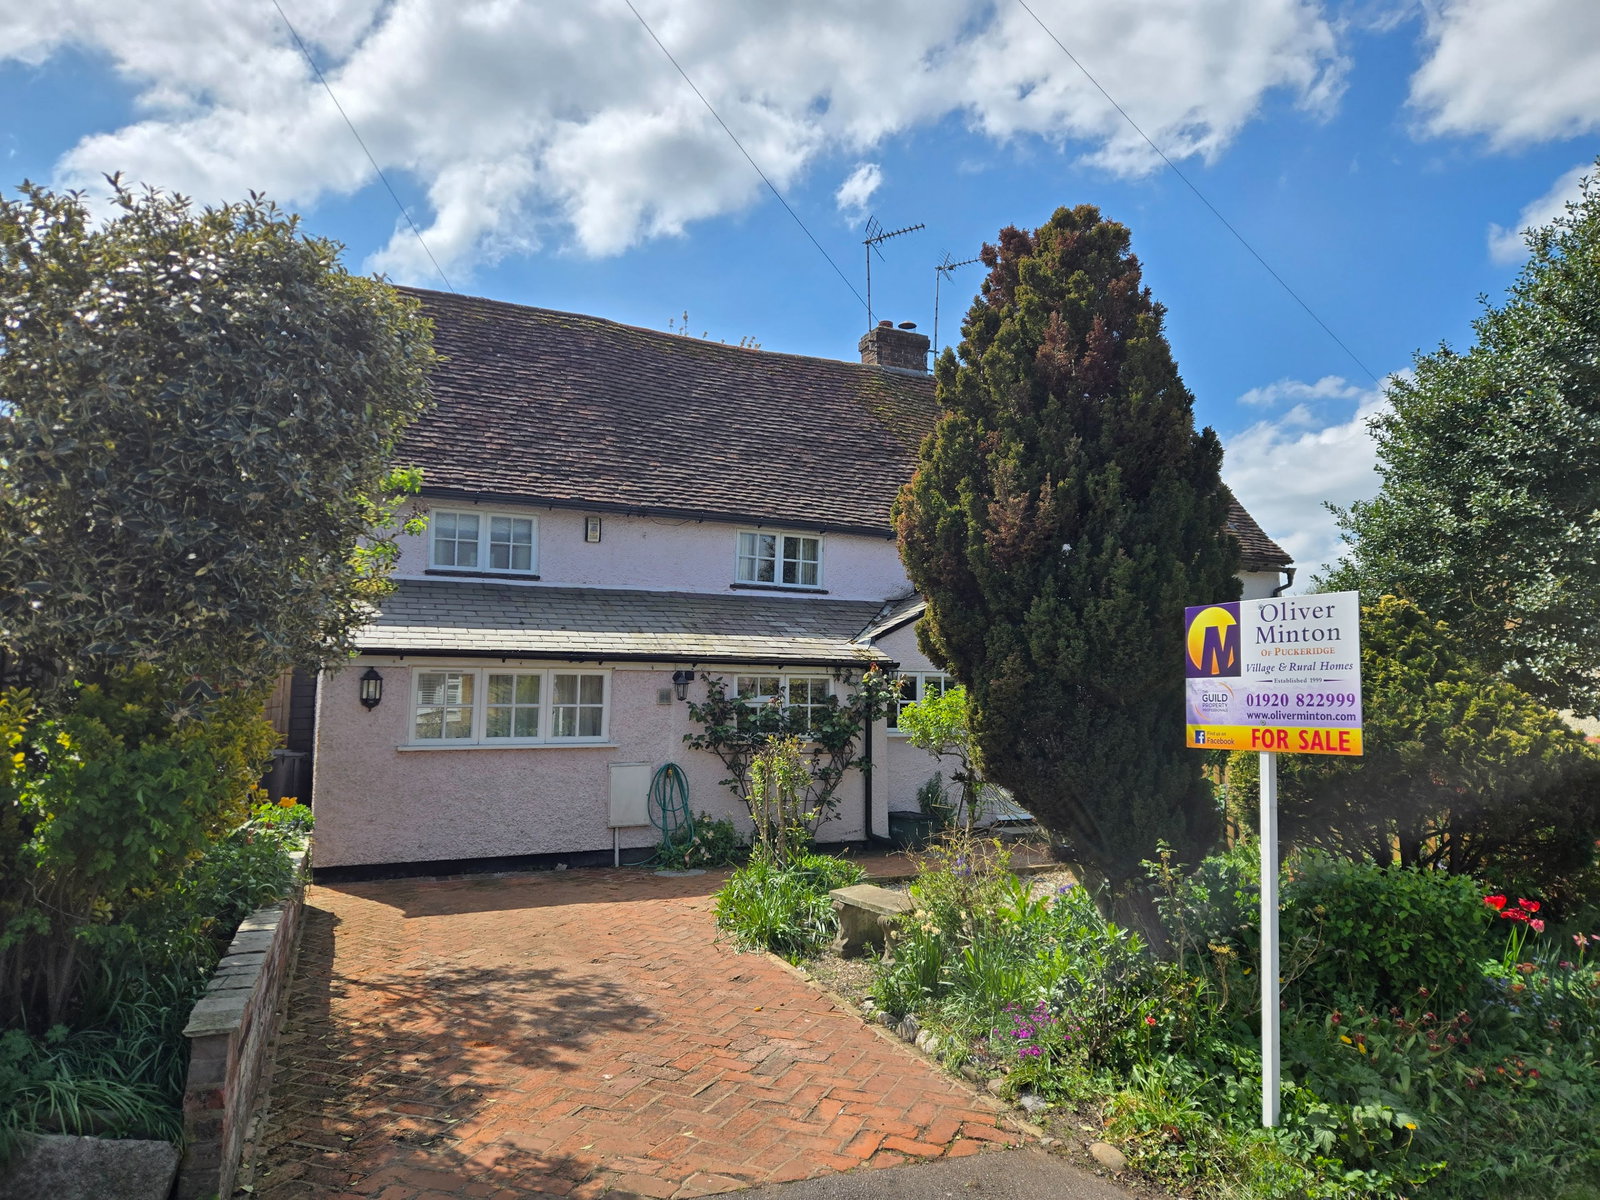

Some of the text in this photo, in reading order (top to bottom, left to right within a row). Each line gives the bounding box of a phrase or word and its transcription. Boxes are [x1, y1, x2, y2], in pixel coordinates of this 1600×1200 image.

[1260, 602, 1335, 623] Oliver
[1256, 624, 1341, 645] Minton
[1246, 661, 1353, 674] Village & Rural Homes
[1202, 694, 1228, 702] GUILD
[1246, 693, 1356, 707] 01920 822999
[1246, 710, 1356, 721] www.oliverminton.com
[1207, 737, 1235, 745] Facebook
[1251, 728, 1351, 752] FOR SALE
